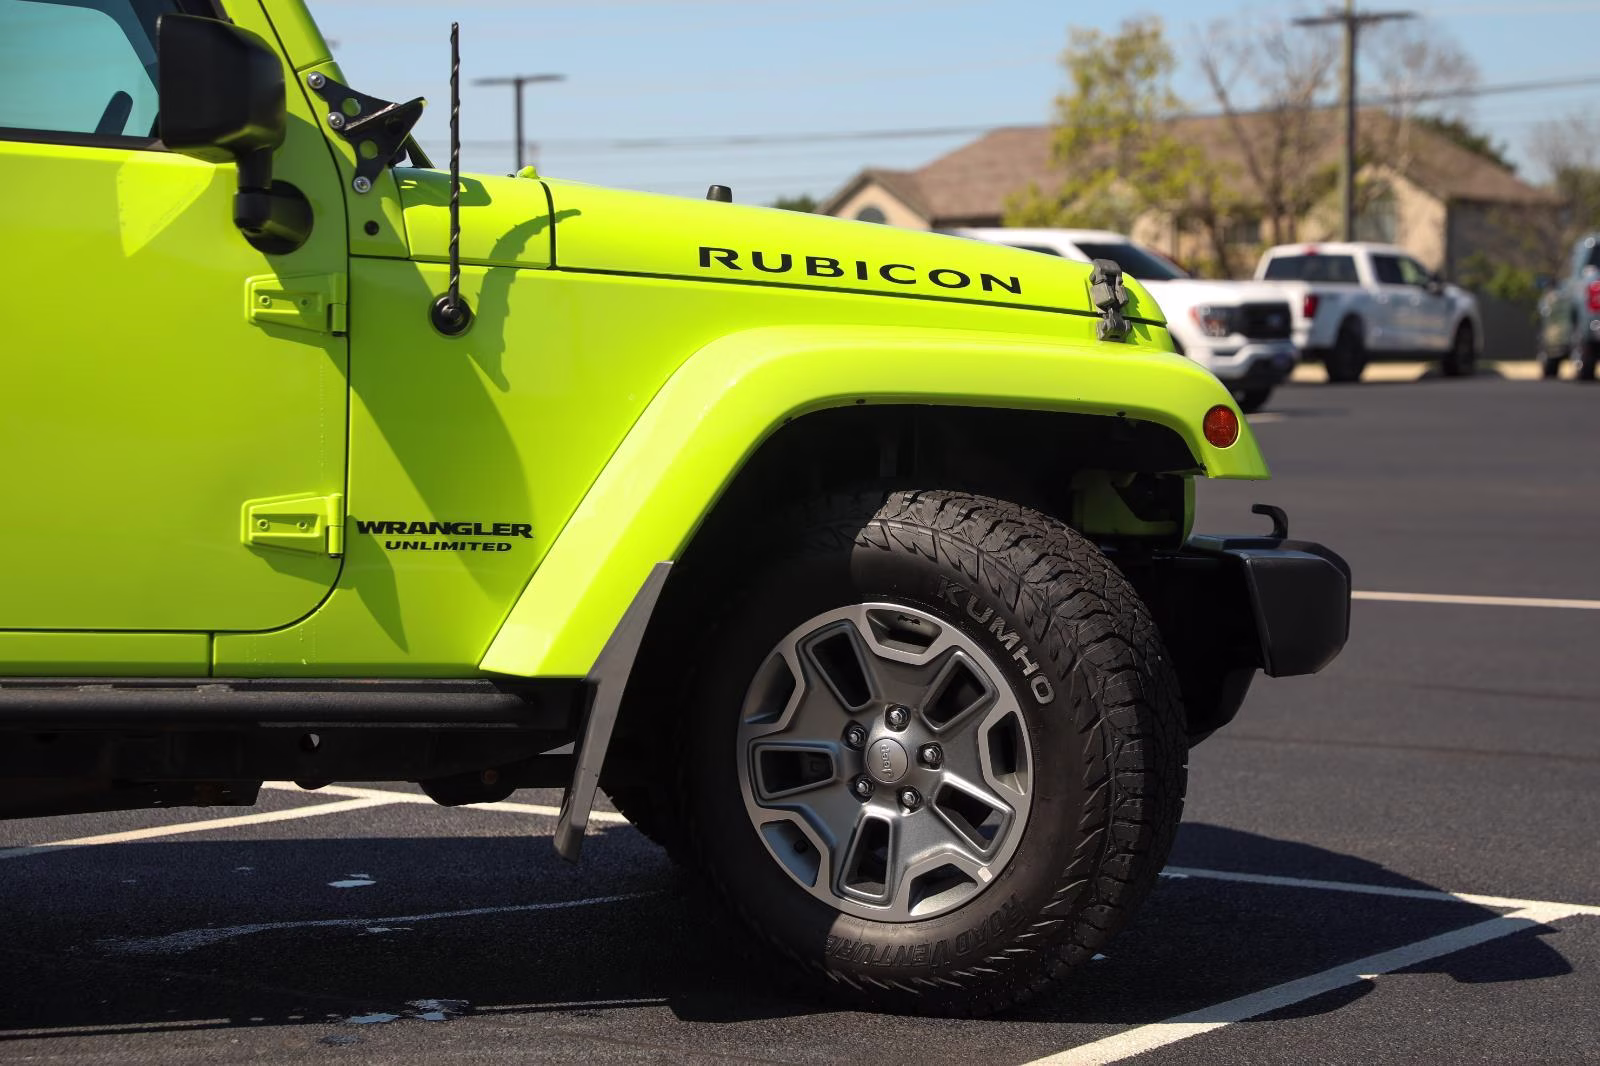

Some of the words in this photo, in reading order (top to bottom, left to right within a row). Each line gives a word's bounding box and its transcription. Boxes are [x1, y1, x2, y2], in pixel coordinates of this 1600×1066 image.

[698, 246, 1022, 294] RUBICON
[356, 520, 534, 538] WRANGLER
[385, 540, 512, 552] UNLIMITED
[937, 575, 1055, 704] KUMHO
[955, 893, 1028, 957] ROAD
[824, 934, 952, 968] VENTURE
